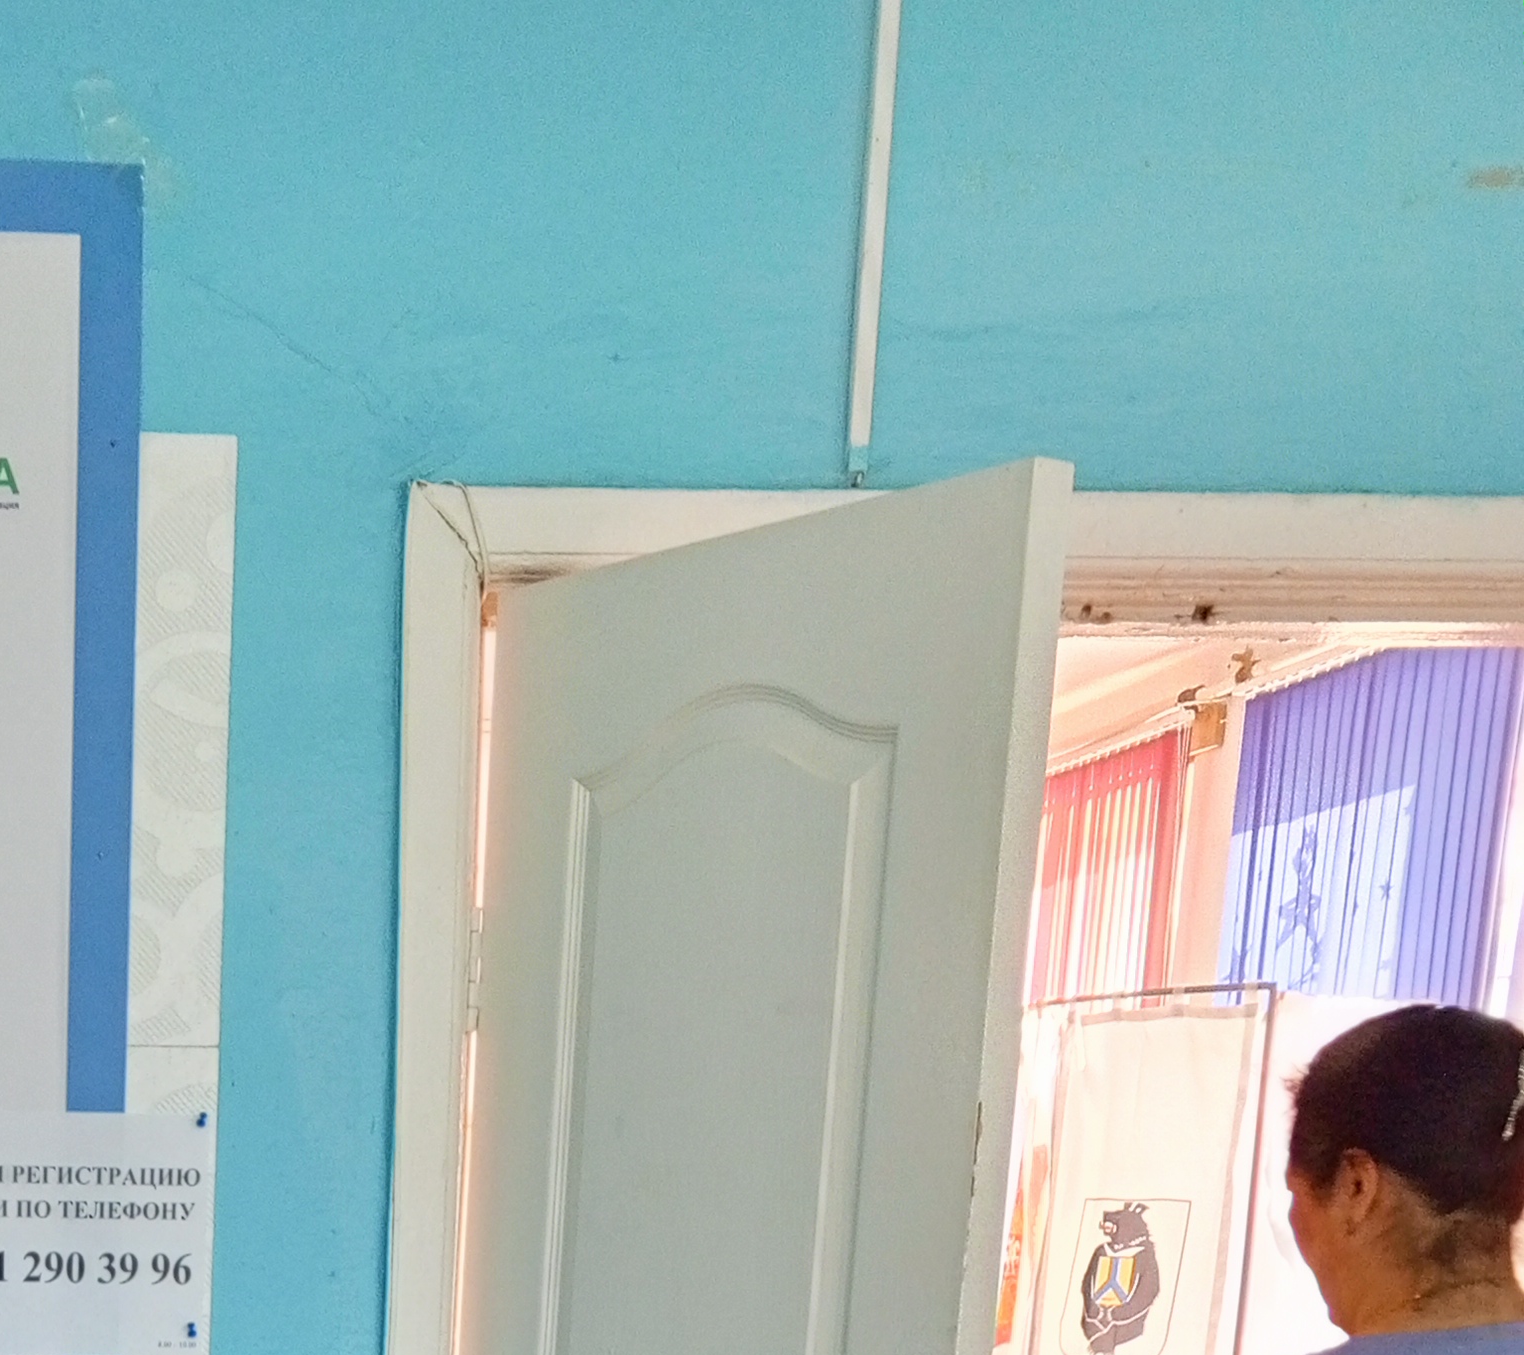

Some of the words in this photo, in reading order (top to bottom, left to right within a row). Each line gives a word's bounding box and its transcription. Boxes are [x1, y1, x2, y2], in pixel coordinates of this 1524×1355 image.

[12, 1165, 201, 1190] РЕГИСТРАЦИЮ
[16, 1200, 52, 1219] ПО
[57, 1200, 196, 1221] ТЕЛЕФОНУ
[22, 1251, 86, 1284] 290
[97, 1252, 139, 1285] 39
[150, 1253, 192, 1286] 96
